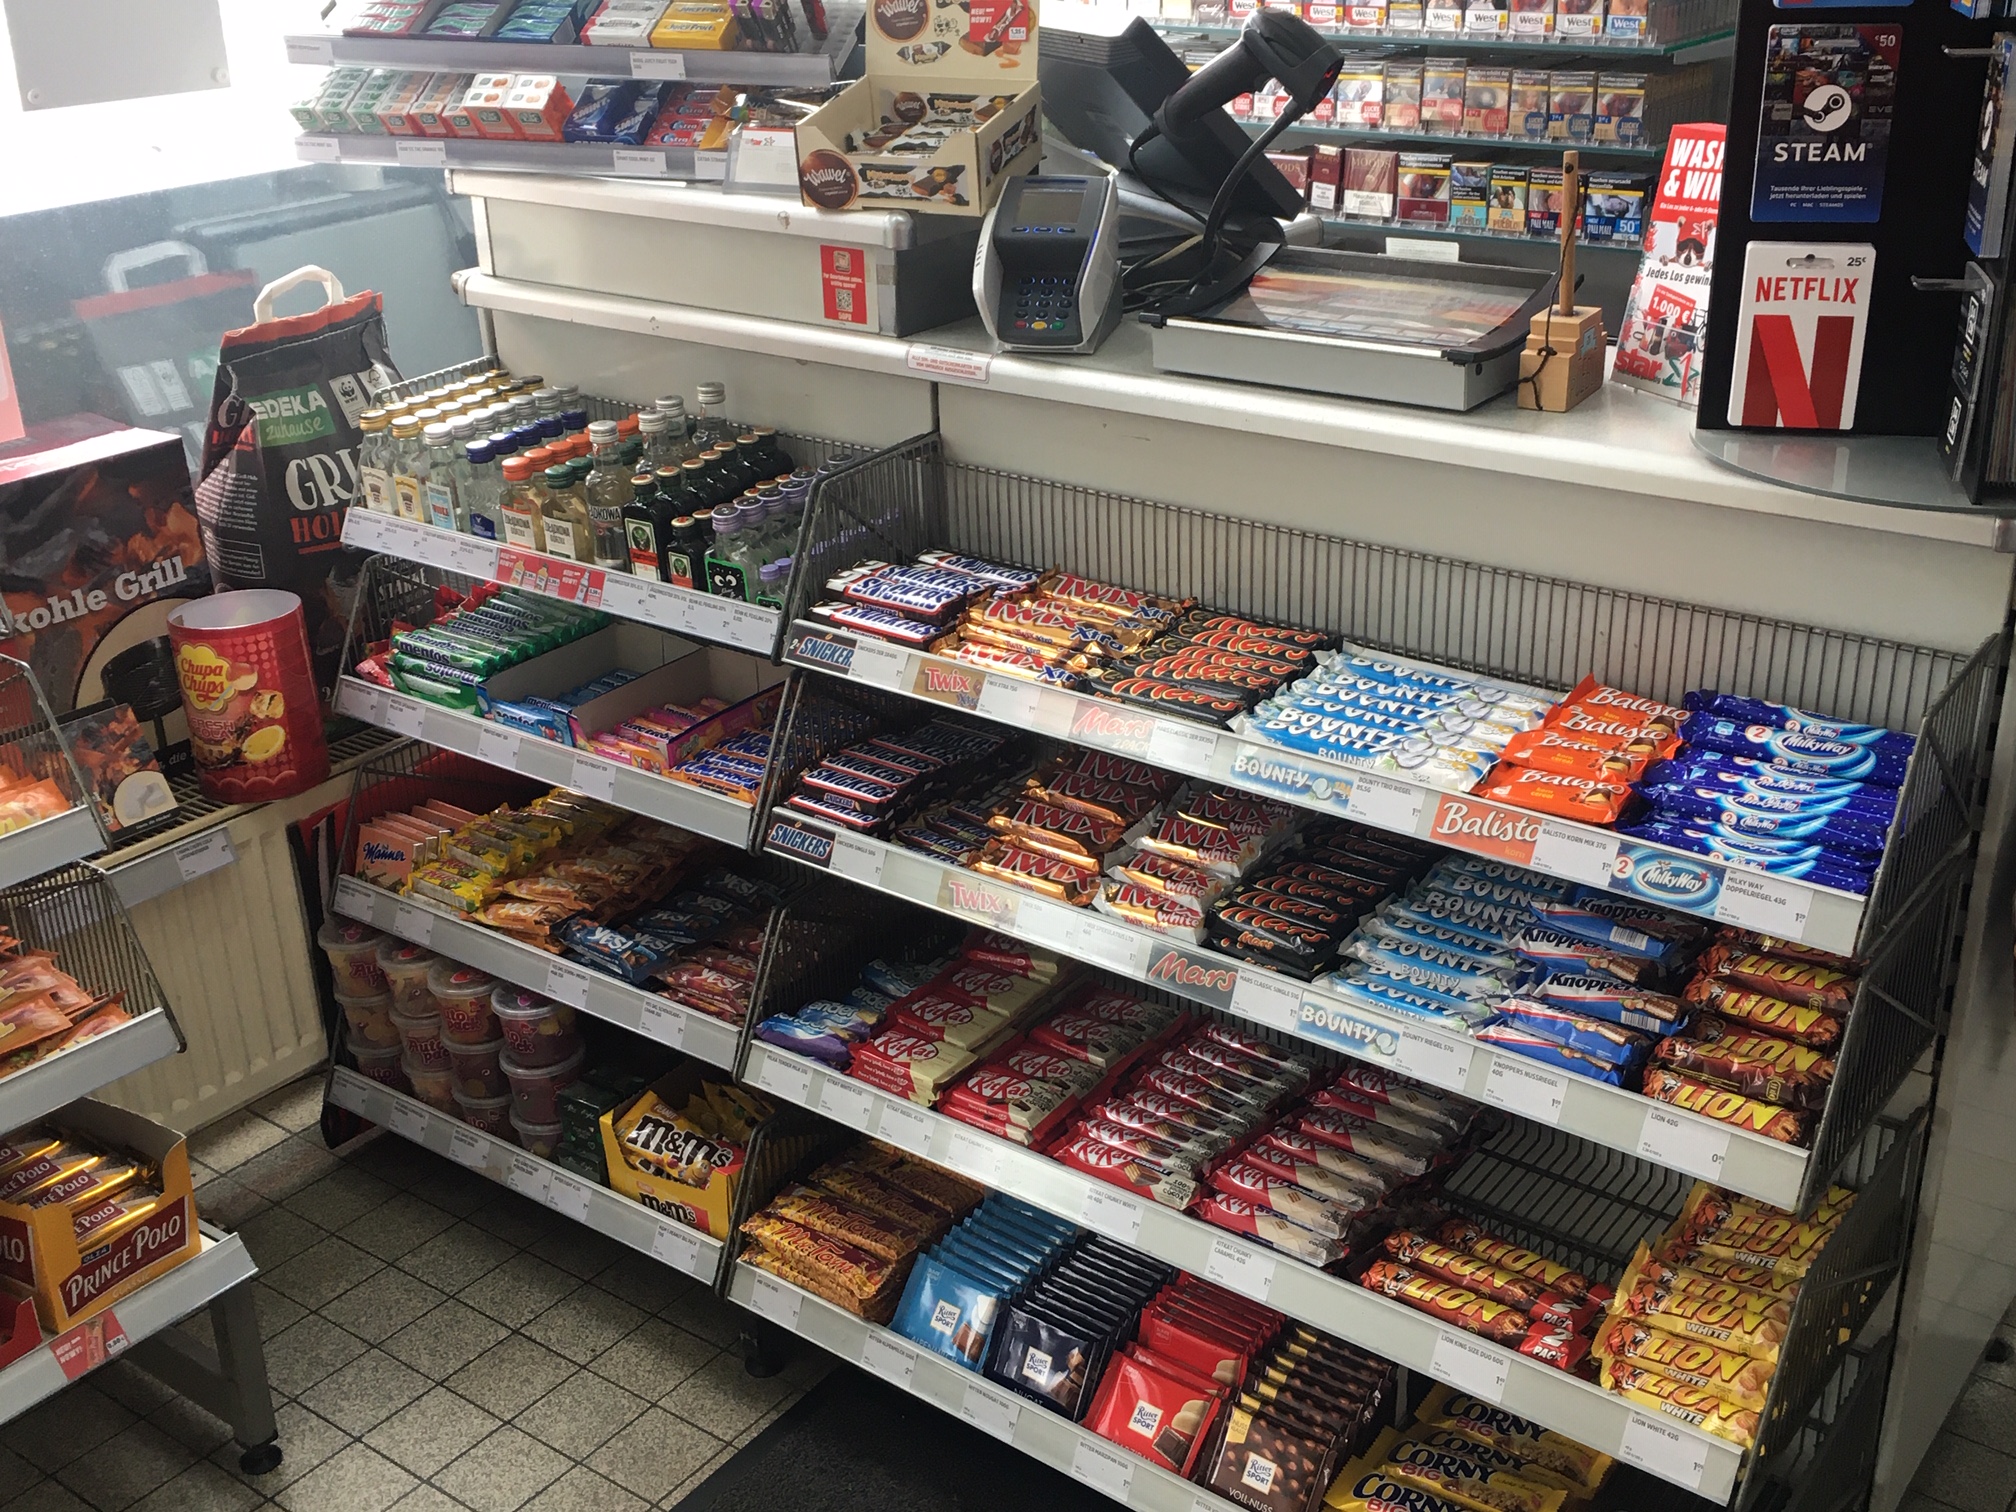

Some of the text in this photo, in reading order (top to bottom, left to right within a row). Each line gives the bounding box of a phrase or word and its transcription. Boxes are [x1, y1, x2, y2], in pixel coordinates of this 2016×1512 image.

[1313, 6, 1335, 17] West
[1355, 8, 1377, 19] West
[1432, 11, 1455, 22] West
[1475, 12, 1498, 23] West
[1519, 14, 1543, 25] West
[1567, 16, 1592, 27] West
[1613, 17, 1640, 29] West
[1351, 157, 1392, 169] MOODS
[1773, 142, 1867, 163] STEAM
[803, 166, 848, 186] Wawel
[1663, 168, 1681, 197] &
[1770, 184, 1800, 193] Tausende
[1619, 219, 1635, 233] 50
[1646, 266, 1669, 281] Jedes
[1669, 270, 1683, 283] Los
[1755, 276, 1860, 305] NETFLIX
[1652, 296, 1681, 318] 1.000
[1613, 348, 1664, 381] star
[248, 389, 328, 421] EDEKA
[265, 415, 326, 441] zuhause
[114, 555, 188, 602] Grill
[479, 608, 530, 631] mentos
[490, 601, 544, 623] mentos
[844, 606, 943, 637] SNICKERS
[1070, 624, 1126, 653] Xtra
[1190, 630, 1311, 661] Mars
[399, 641, 451, 665] mentos
[180, 657, 224, 683] Chupa
[924, 666, 971, 693] Twix
[182, 673, 226, 696] Chups
[1111, 676, 1243, 712] Mars
[1333, 673, 1458, 708] BOUNTY
[1585, 686, 1691, 722] Balisto
[190, 718, 236, 730] FRESH
[1072, 705, 1153, 739] Mars
[1277, 706, 1405, 747] BOUNTY
[1559, 710, 1669, 741] Balisto
[1318, 746, 1376, 769] BOUNTY
[808, 767, 894, 799] SNICKERS
[1233, 754, 1312, 790] BOUNTY
[1358, 776, 1380, 788] BOUNTY
[1515, 768, 1627, 795] Balisto
[1015, 800, 1115, 845] TWIX
[1158, 814, 1245, 852] TWIX
[1436, 800, 1541, 842] Balisto
[769, 822, 835, 860] SNICKERS
[1542, 827, 1608, 851] BALISTO KORN MIX 37G
[362, 841, 407, 865] Manner
[1196, 846, 1241, 863] white
[1001, 845, 1099, 892] TWIX
[1616, 857, 1629, 874] 2
[1725, 883, 1788, 907] DOPPELRIEGEL 43G
[1727, 875, 1765, 891] MILKY WAY
[949, 880, 1002, 914] Twix
[1156, 909, 1200, 929] white
[1579, 898, 1668, 923] Knoppers
[1219, 905, 1332, 944] Mars
[587, 925, 635, 952] YES!
[633, 931, 676, 952] YES!
[1238, 931, 1276, 951] Mars
[1377, 934, 1495, 976] BOUNTY
[699, 967, 745, 992] YES!
[1148, 949, 1237, 992] Mars
[1401, 962, 1461, 988] BOUNTY
[1548, 971, 1645, 993] Knoppers
[1735, 954, 1847, 990] LION
[1239, 974, 1253, 986] MARS
[1253, 979, 1273, 992] CLASSIC
[1273, 985, 1291, 998] SINGLE
[911, 1002, 974, 1026] KitKat
[1299, 1001, 1379, 1045] BOUNTY
[1720, 991, 1822, 1034] LION
[873, 1036, 940, 1061] KitKat
[1401, 1031, 1455, 1054] BOUNTY RIEGEL 57G
[1007, 1053, 1074, 1079] KitKat
[1493, 1060, 1559, 1089] KNOPPERS NUSSRIEGEL
[966, 1074, 1034, 1099] KitKat
[653, 1103, 679, 1120] PEANUT
[1672, 1083, 1785, 1132] LION
[1650, 1112, 1679, 1128] LION 42G
[1071, 1138, 1136, 1169] KitKat
[12, 1160, 52, 1184] POLO
[50, 1174, 90, 1198] POLO
[77, 1203, 117, 1229] POLO
[65, 1212, 182, 1309] PRINCE POLO
[1415, 1244, 1526, 1289] LION
[1471, 1238, 1572, 1286] LION
[1733, 1251, 1779, 1269] WHITE
[1401, 1276, 1515, 1324] LION
[933, 1314, 955, 1331] SPORT
[937, 1304, 958, 1322] Ritter
[1543, 1311, 1573, 1329] PACK
[1666, 1293, 1768, 1335] LION
[1540, 1328, 1575, 1348] 2
[1685, 1321, 1732, 1343] WHITE
[1029, 1351, 1050, 1370] Ritter
[1440, 1333, 1505, 1367] LION KING SIZE DUO 60G
[1532, 1345, 1567, 1362] PACK
[1647, 1337, 1752, 1384] LION
[1026, 1362, 1047, 1378] SPORT
[1663, 1367, 1710, 1389] WHITE
[1132, 1416, 1156, 1432] SPORT
[1136, 1405, 1159, 1424] Ritter
[1442, 1393, 1551, 1443] CORNY
[1659, 1401, 1706, 1427] WHITE
[1454, 1415, 1495, 1438] BIG
[1631, 1415, 1680, 1443] LION WHITE 42G
[1079, 1440, 1096, 1455] RITTER
[1249, 1458, 1273, 1477] Ritter
[1386, 1440, 1498, 1485] CORNY
[1400, 1462, 1443, 1482] BIG
[1245, 1469, 1270, 1487] SPORT
